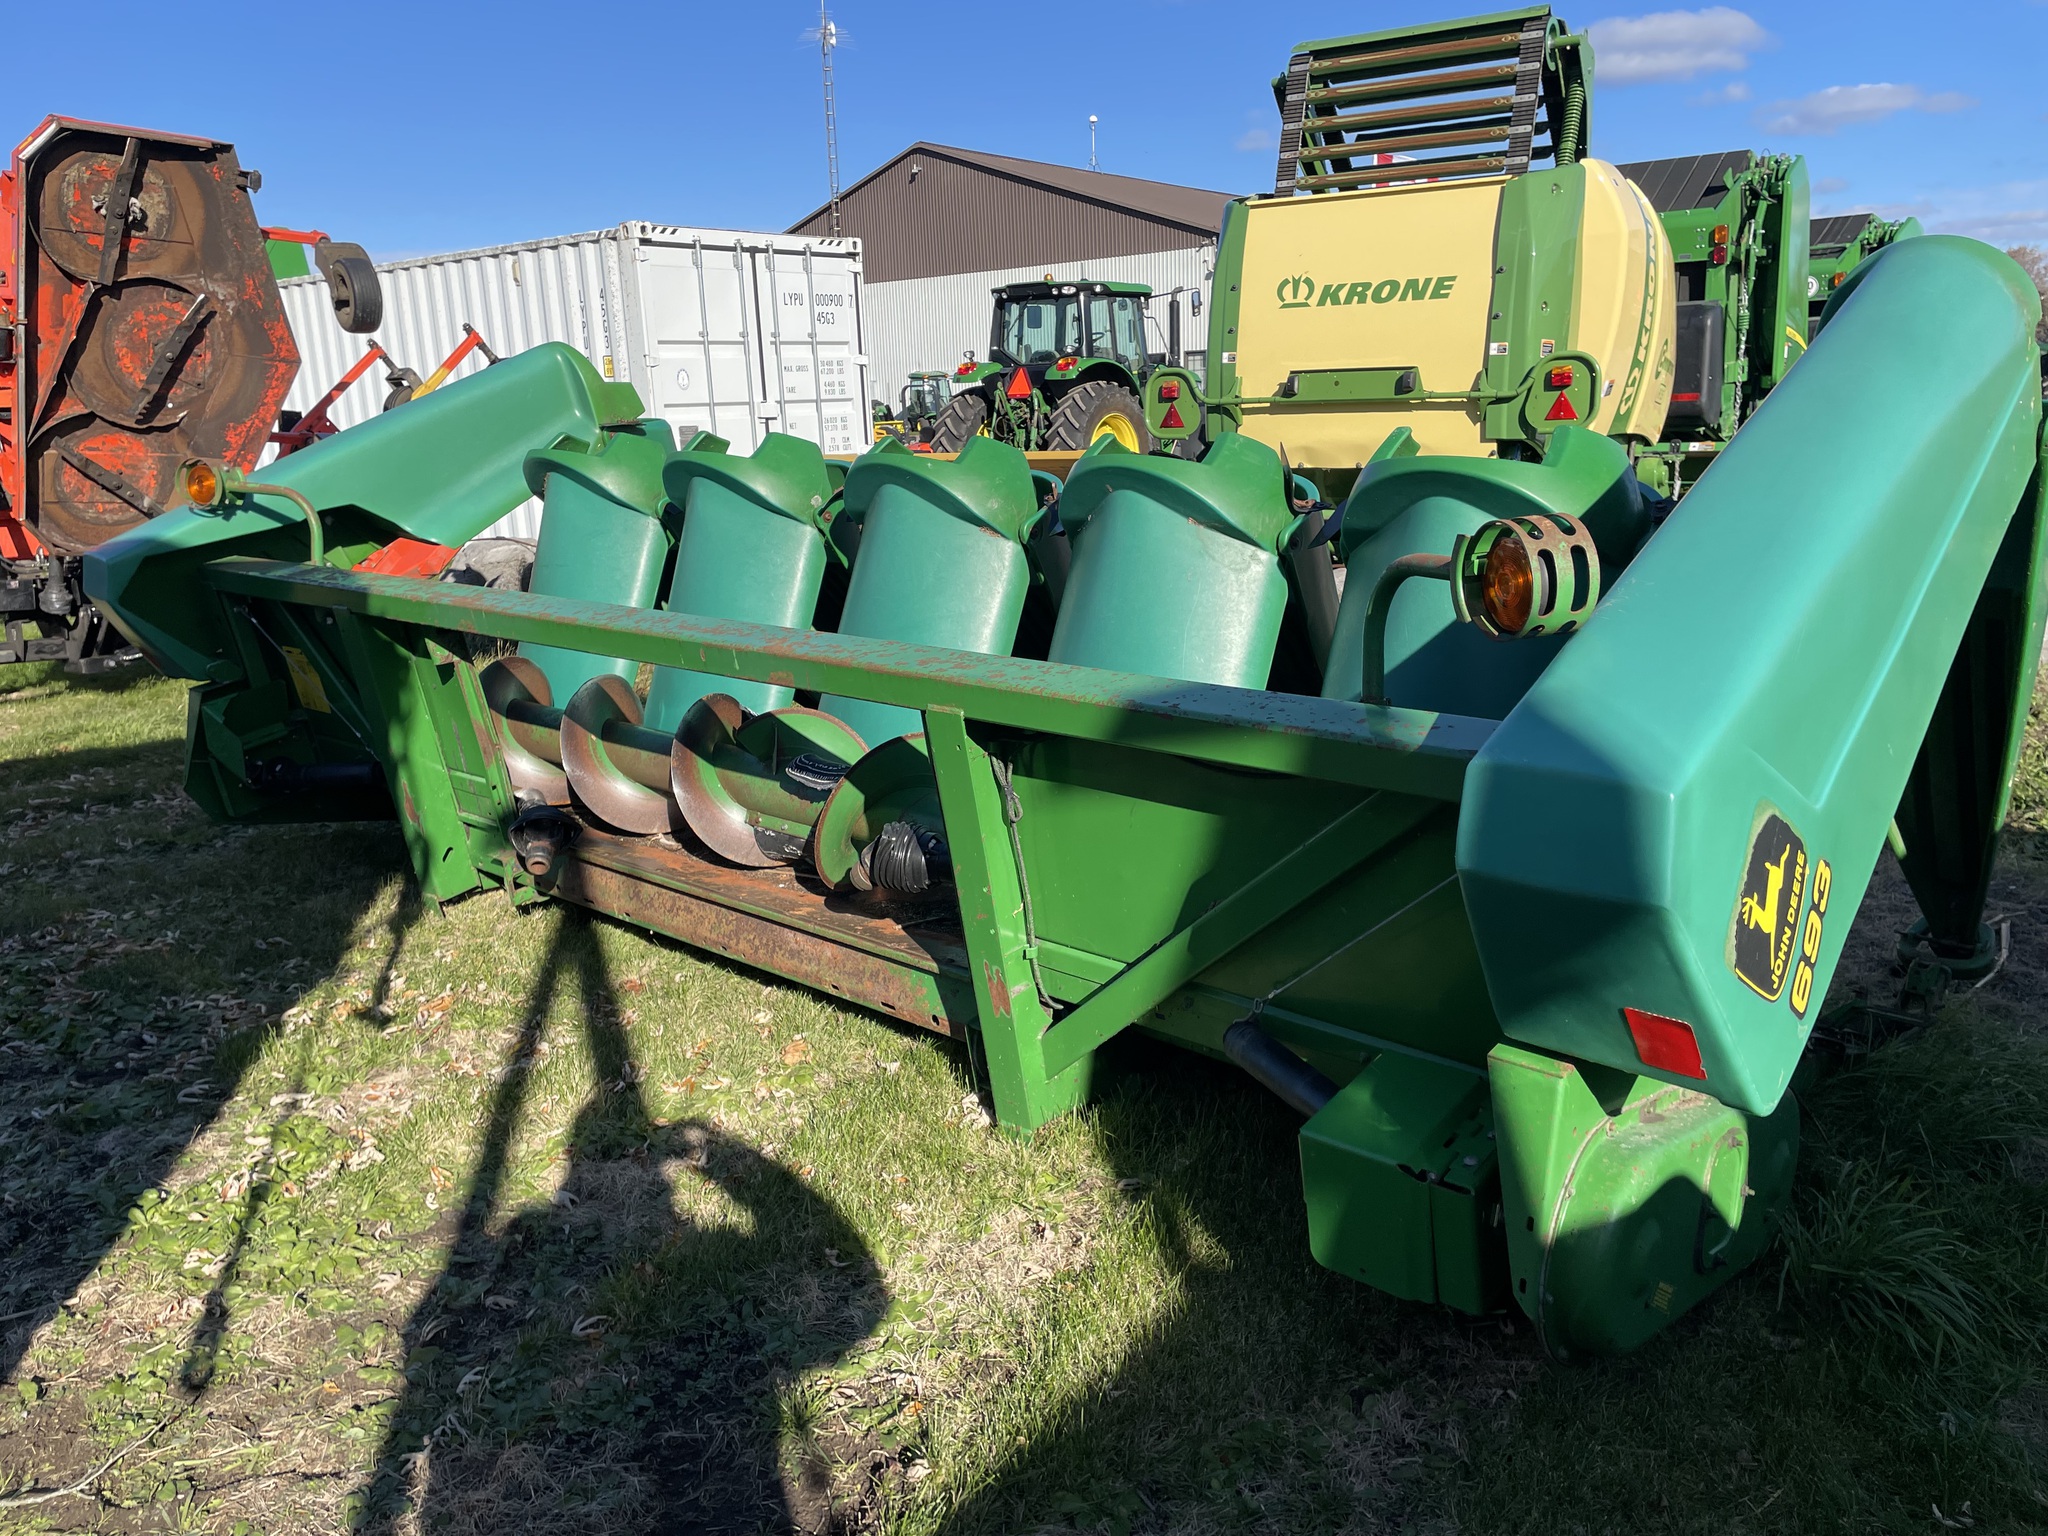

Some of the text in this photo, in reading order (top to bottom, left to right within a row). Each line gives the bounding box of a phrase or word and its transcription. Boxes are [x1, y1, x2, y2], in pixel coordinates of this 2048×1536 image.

[578, 289, 588, 349] LYPU
[599, 288, 610, 349] 45G3
[783, 292, 854, 308] LYPU 000900 7
[816, 312, 835, 325] 45G3
[1316, 275, 1458, 307] KRONE
[1770, 849, 1805, 990] JOHN DEERE
[1790, 858, 1832, 1015] 693
